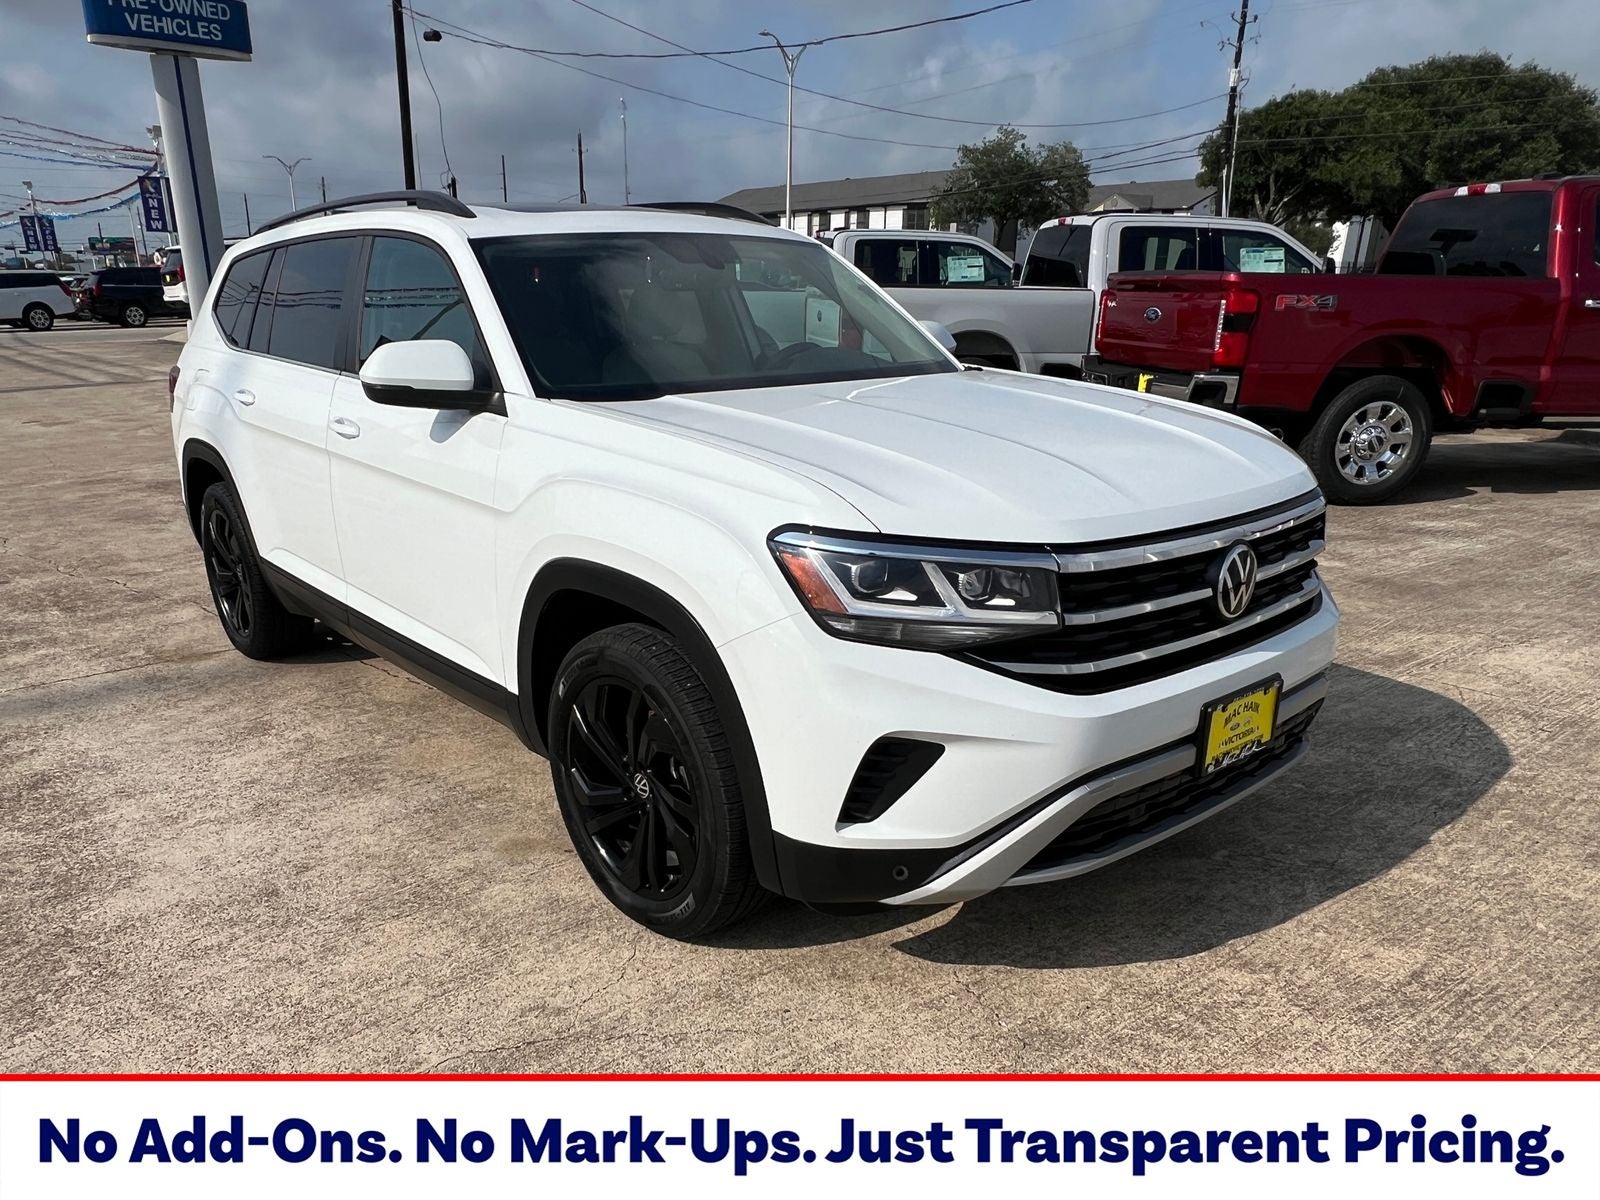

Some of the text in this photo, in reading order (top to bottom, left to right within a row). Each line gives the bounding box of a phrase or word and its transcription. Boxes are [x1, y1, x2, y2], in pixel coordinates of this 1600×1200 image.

[124, 12, 222, 41] VEHICLES
[148, 198, 163, 230] NEW
[1276, 294, 1338, 311] FX4
